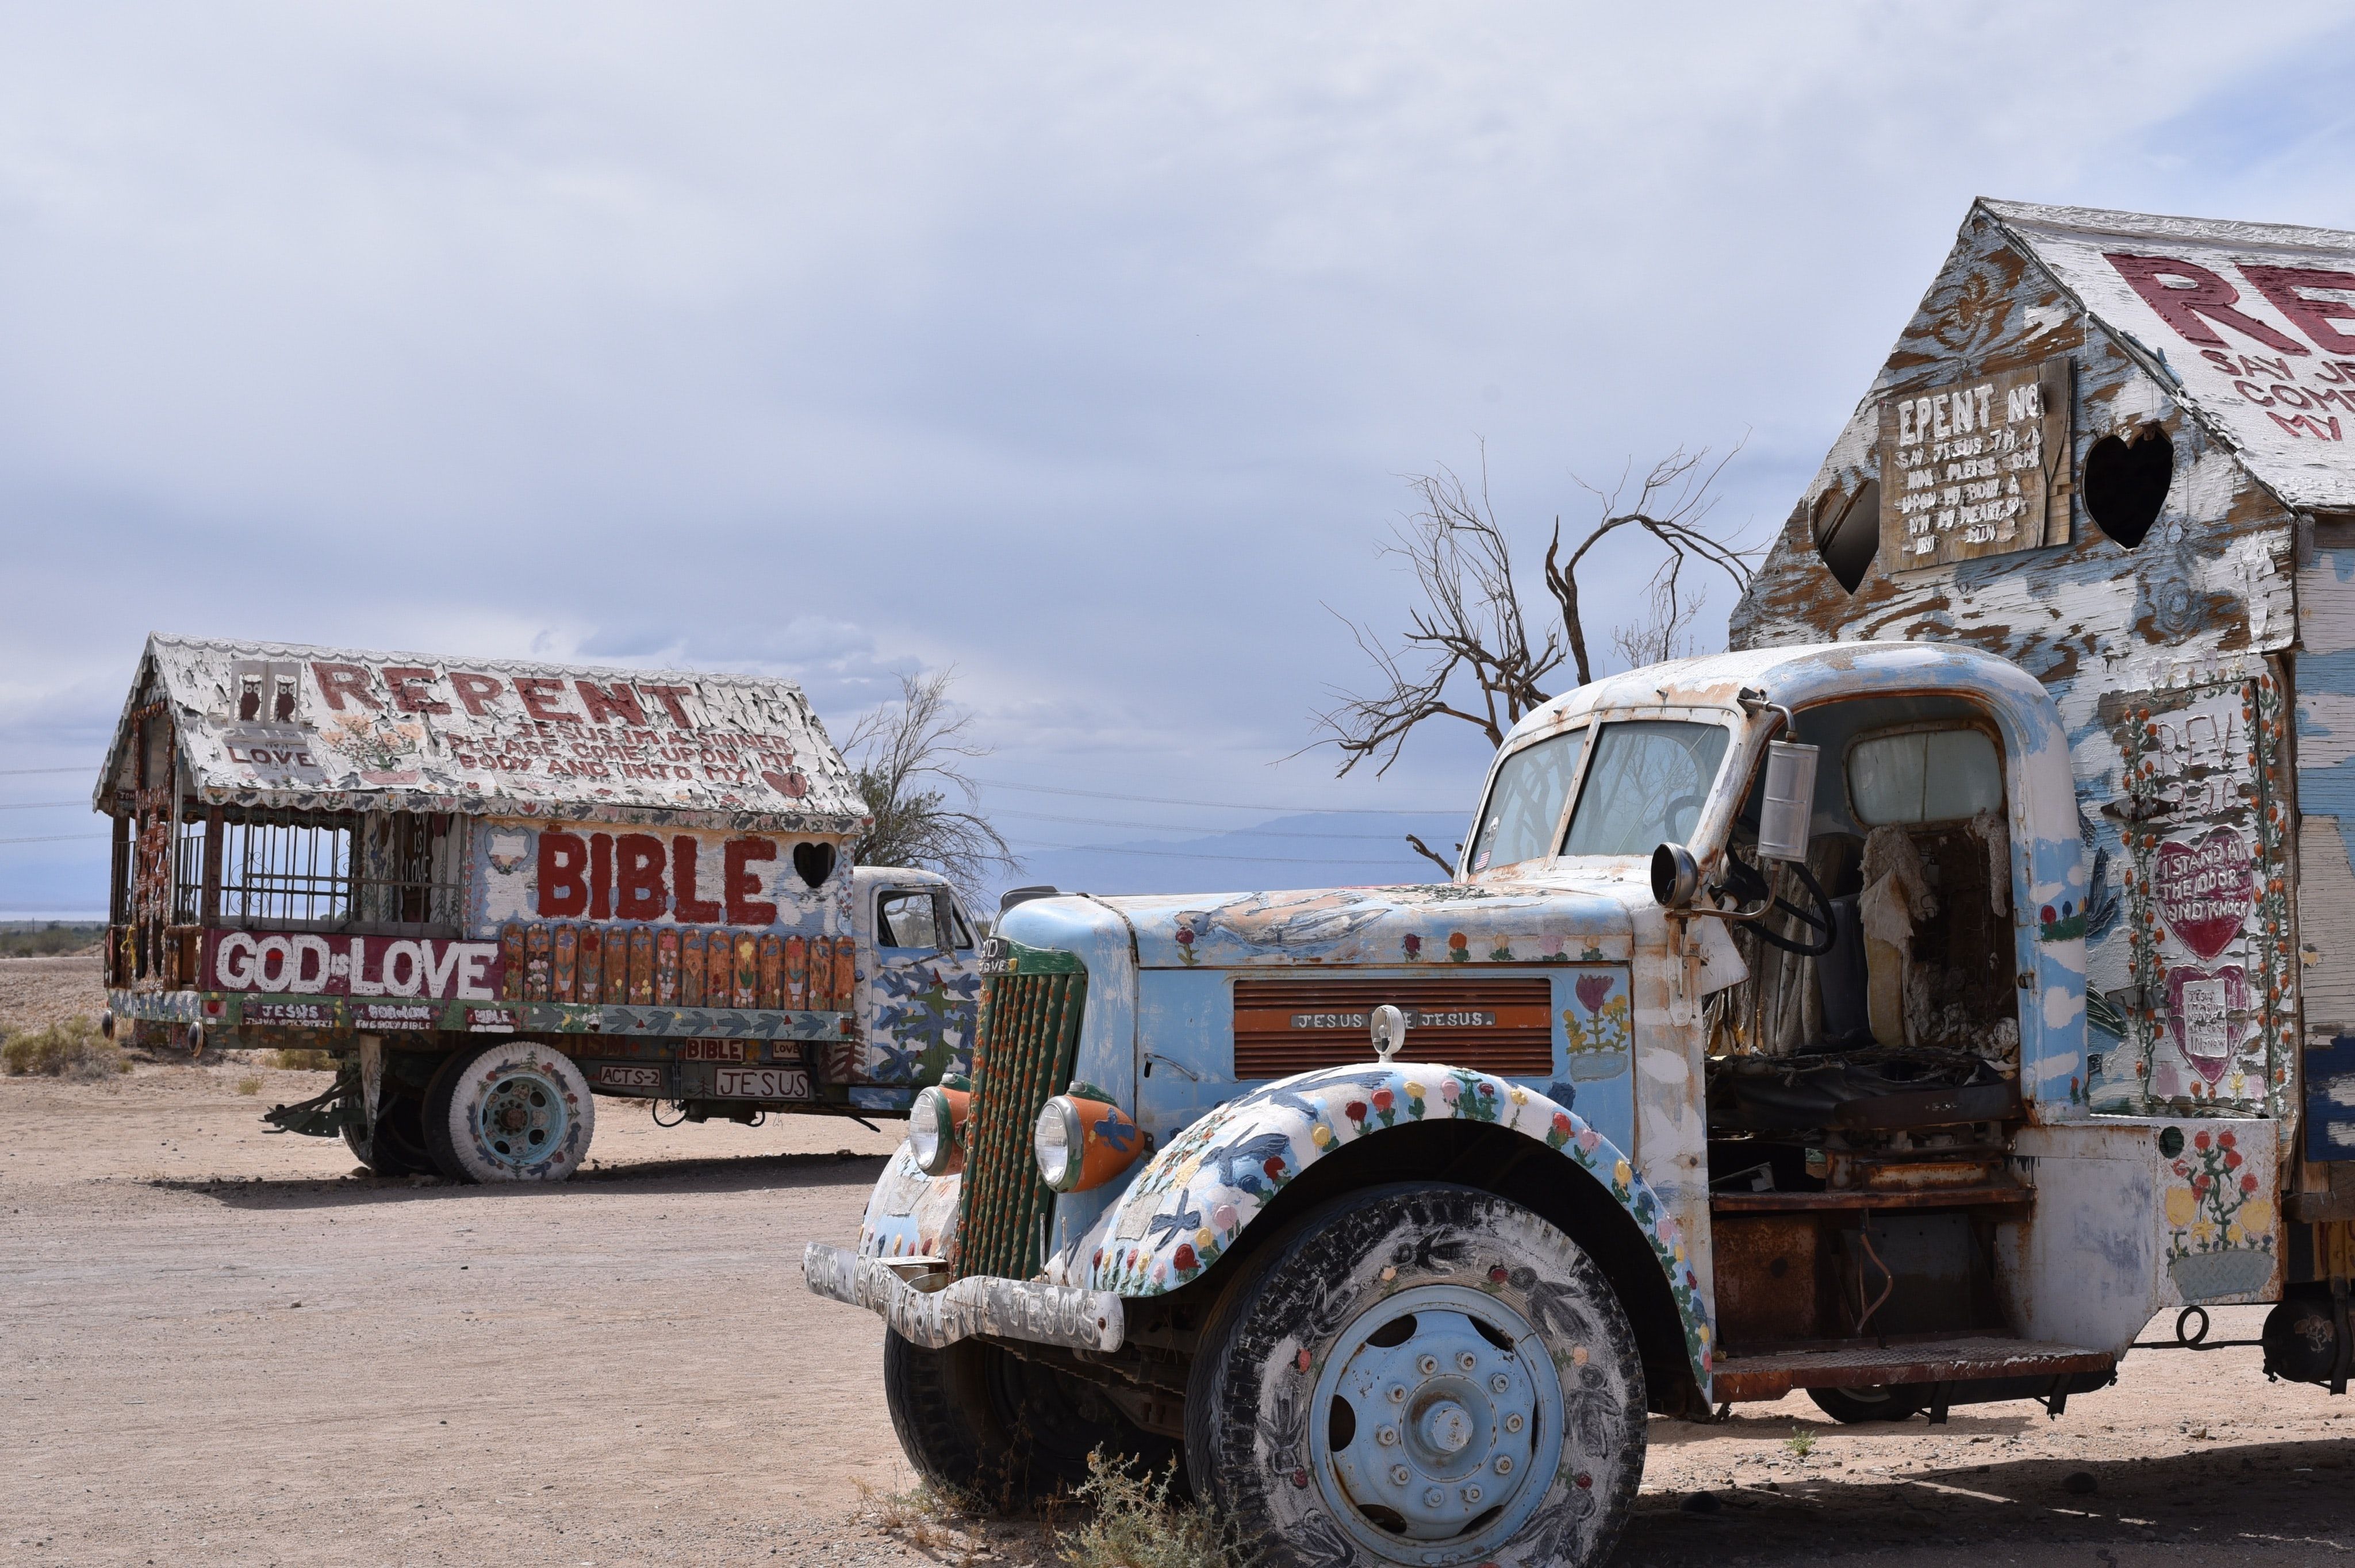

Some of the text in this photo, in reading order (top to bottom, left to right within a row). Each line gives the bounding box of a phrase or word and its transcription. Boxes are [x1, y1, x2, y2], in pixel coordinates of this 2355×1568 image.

[2200, 349, 2295, 381] SAY
[1898, 383, 1994, 447] EPENT
[2265, 411, 2343, 441] MY
[310, 661, 695, 730] REPENT
[227, 745, 317, 767] LOVE
[446, 733, 793, 767] PLEASE COME UPON MY
[696, 732, 792, 750] SINNER
[2158, 710, 2233, 776] REV
[547, 759, 609, 777] AND
[622, 763, 693, 781] INTO
[704, 764, 747, 782] MY
[2166, 774, 2239, 824] 3-20
[413, 829, 423, 854] IS
[2172, 844, 2223, 876] STAND
[537, 832, 777, 926] BIBLE
[2160, 868, 2240, 900] THE DOOR
[2207, 900, 2248, 921] KNOCK
[216, 931, 331, 993] GOD
[350, 937, 499, 1001] LOVE
[262, 1004, 319, 1019] JESUS
[401, 1021, 431, 1030] BIBLE
[1298, 1014, 1363, 1028] JESUS
[686, 1039, 742, 1059] BIBLE
[774, 1044, 800, 1054] LOVE
[720, 1071, 808, 1097] JESUS
[1009, 1283, 1096, 1346] JESUS
